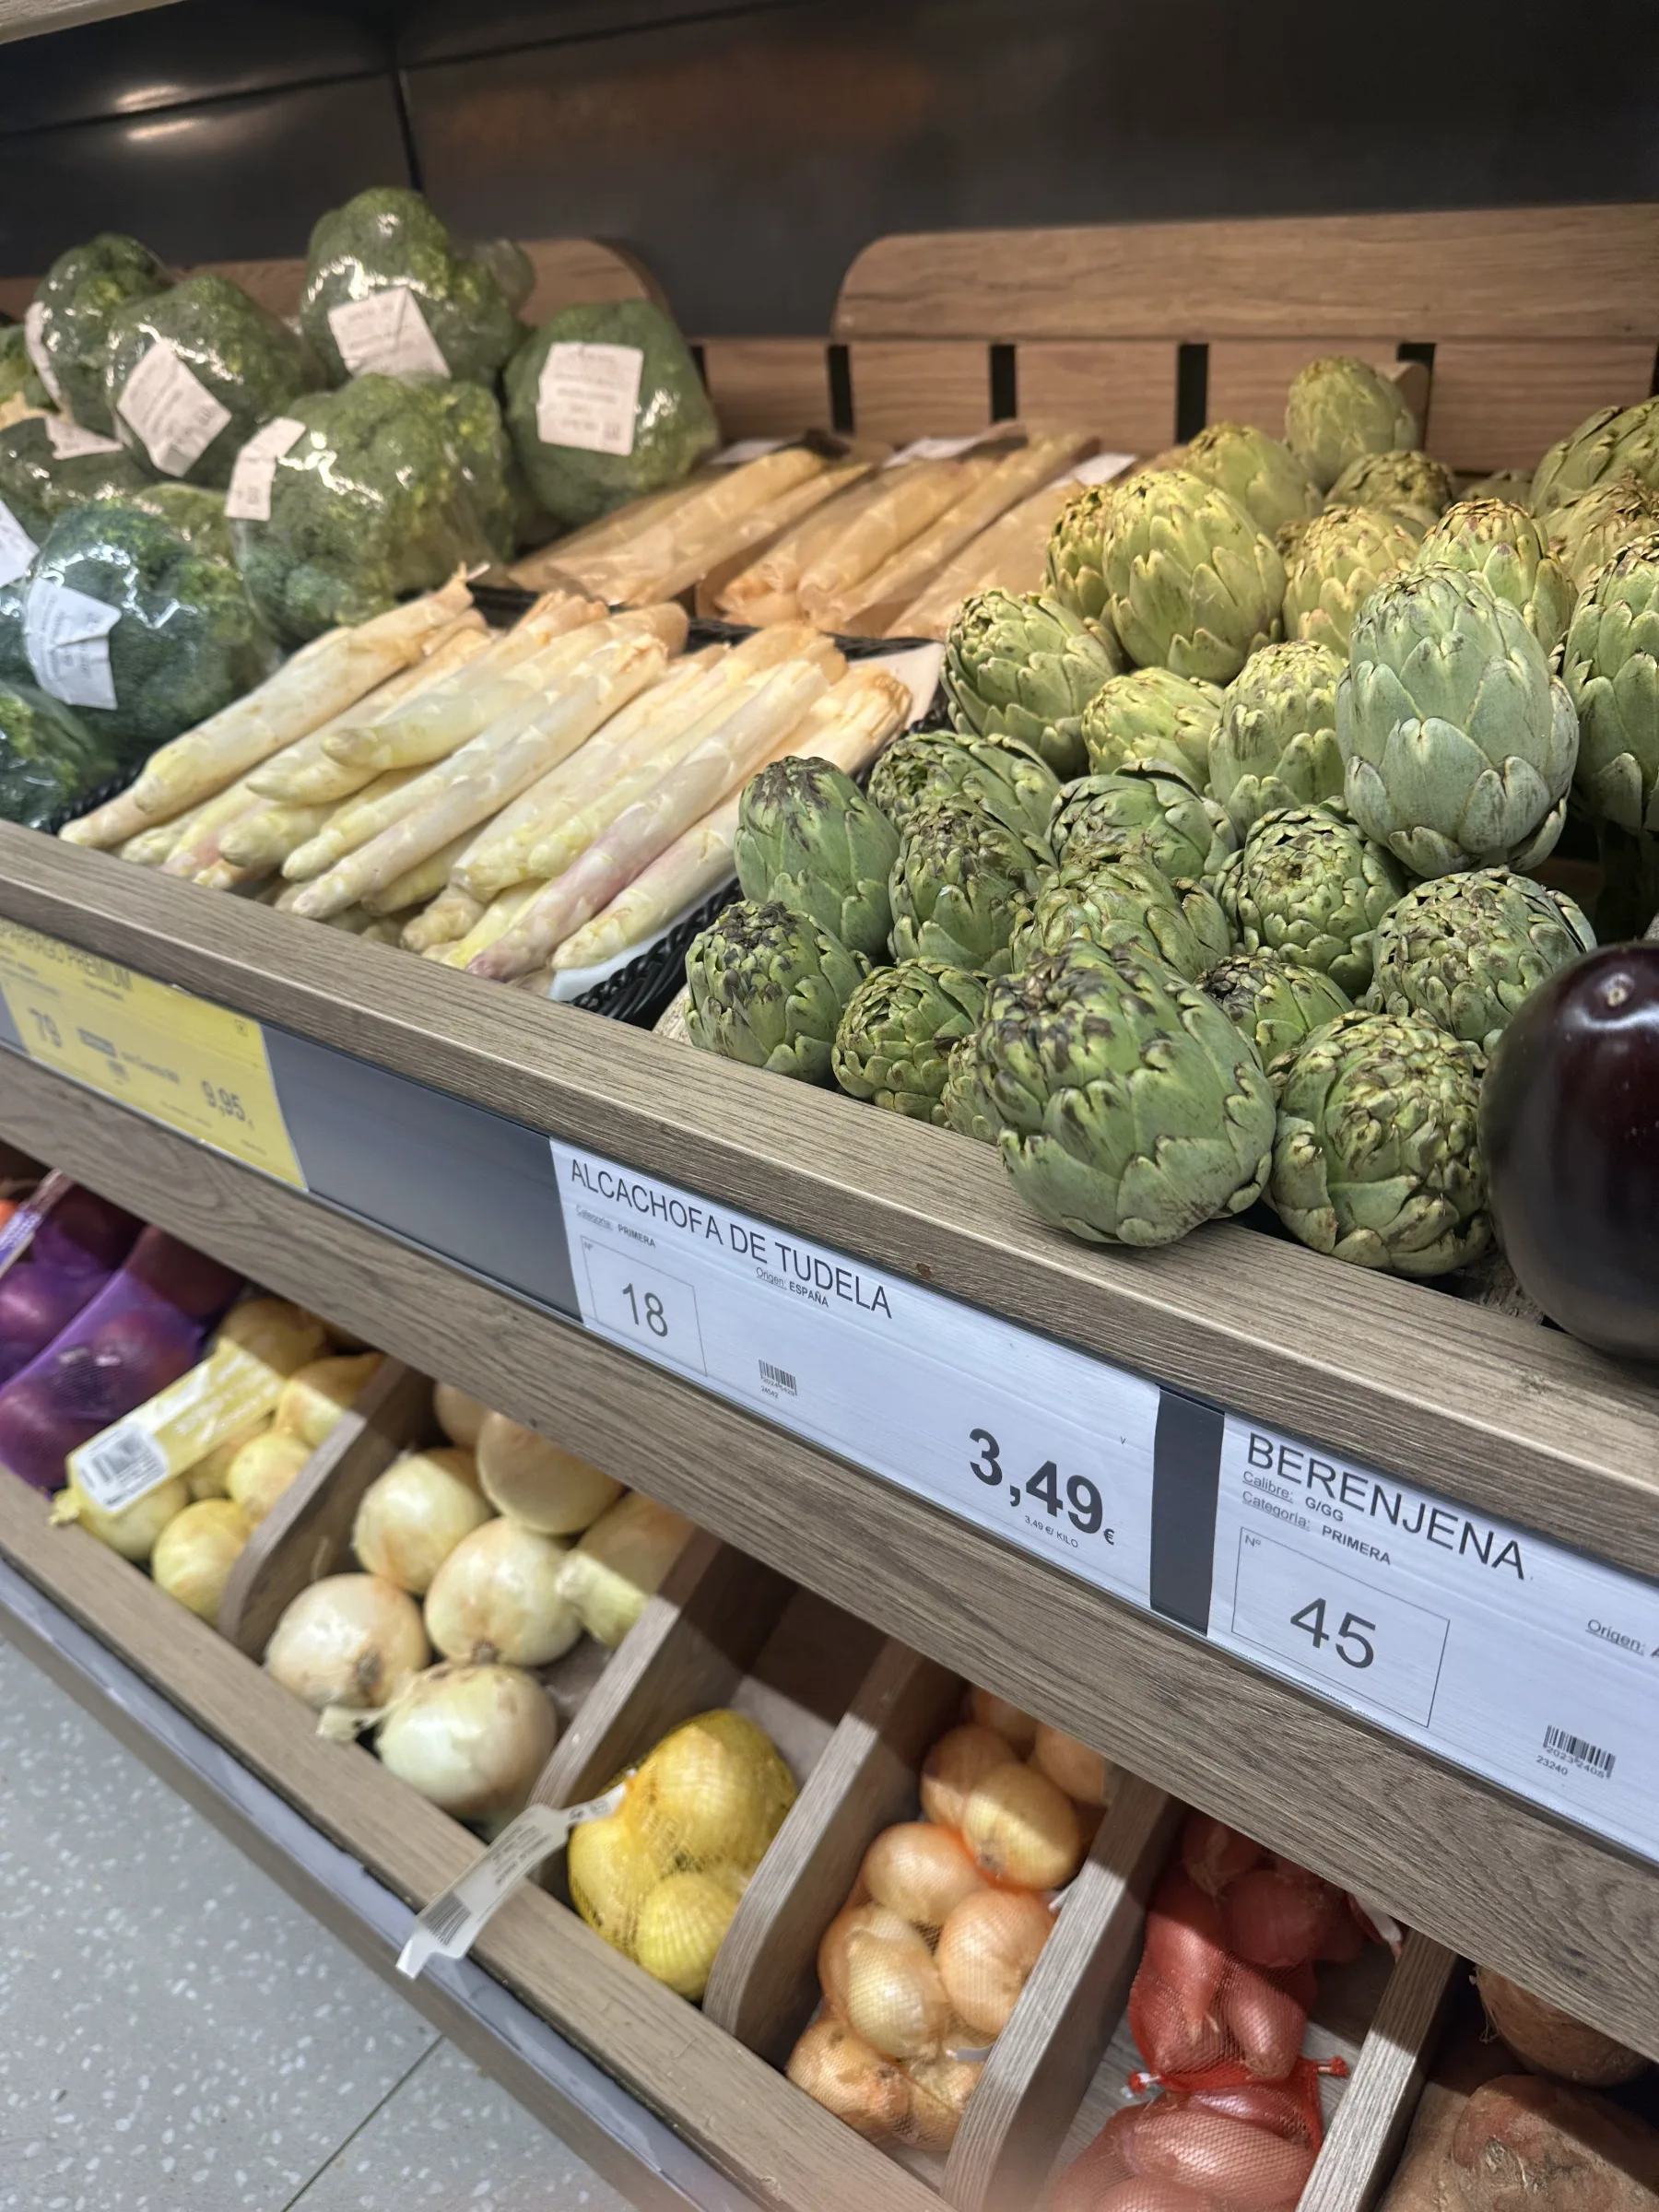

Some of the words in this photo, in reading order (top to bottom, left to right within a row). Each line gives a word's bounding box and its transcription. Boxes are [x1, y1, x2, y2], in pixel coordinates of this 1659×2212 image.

[571, 1159, 724, 1246] ALCACHOFA
[730, 1223, 769, 1265] DE
[774, 1241, 893, 1320] TUDELA
[618, 1223, 656, 1249] PRIMERA
[756, 1266, 788, 1291] Origen:
[789, 1280, 830, 1308] ESPAÑA
[621, 1282, 669, 1337] 18
[1241, 1470, 1294, 1504] Calibre:
[1304, 1496, 1344, 1523] G/GG
[1246, 1431, 1525, 1581] BERENJENA
[1056, 1530, 1078, 1548] KILO
[1322, 1524, 1391, 1565] PRIMERA
[1289, 1596, 1377, 1669] 45
[1585, 1618, 1646, 1656] Origen:
[1535, 1755, 1569, 1776] 23240
